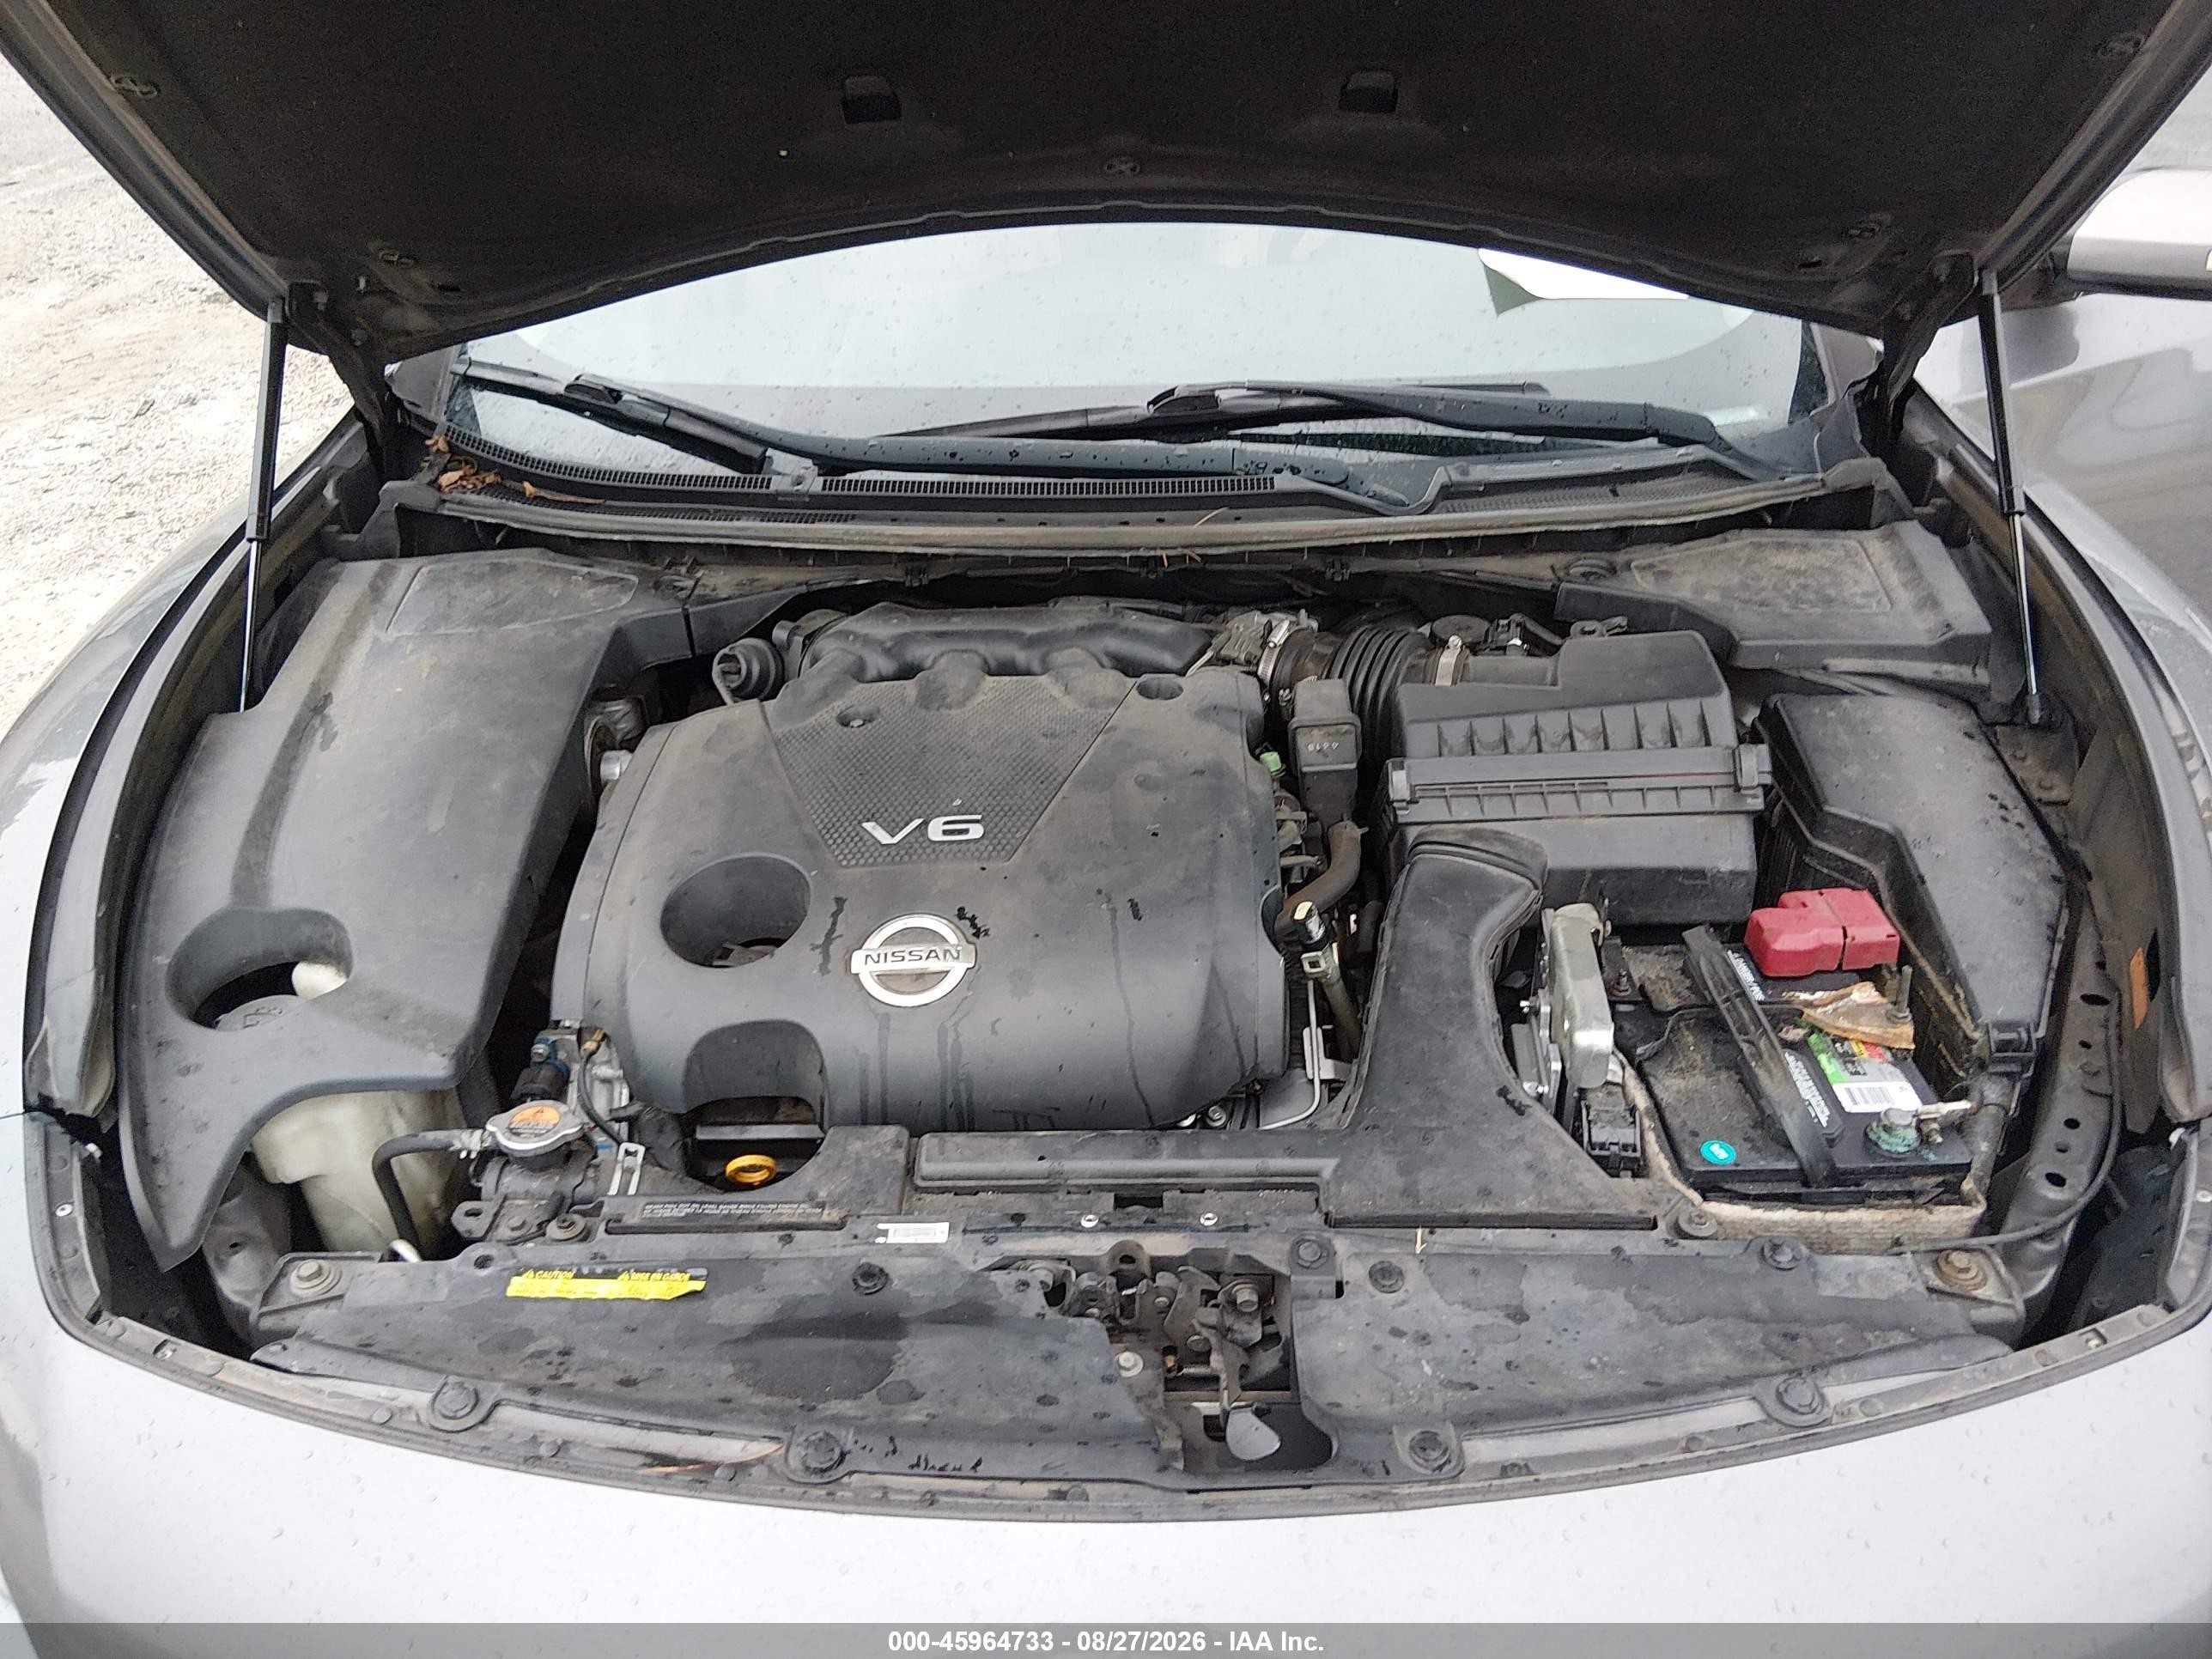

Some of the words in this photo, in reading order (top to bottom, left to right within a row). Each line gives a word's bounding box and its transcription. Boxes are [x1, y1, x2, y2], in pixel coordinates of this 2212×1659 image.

[861, 814, 984, 844] V6
[864, 946, 961, 966] NISSAN
[537, 1270, 575, 1279] CAUTION
